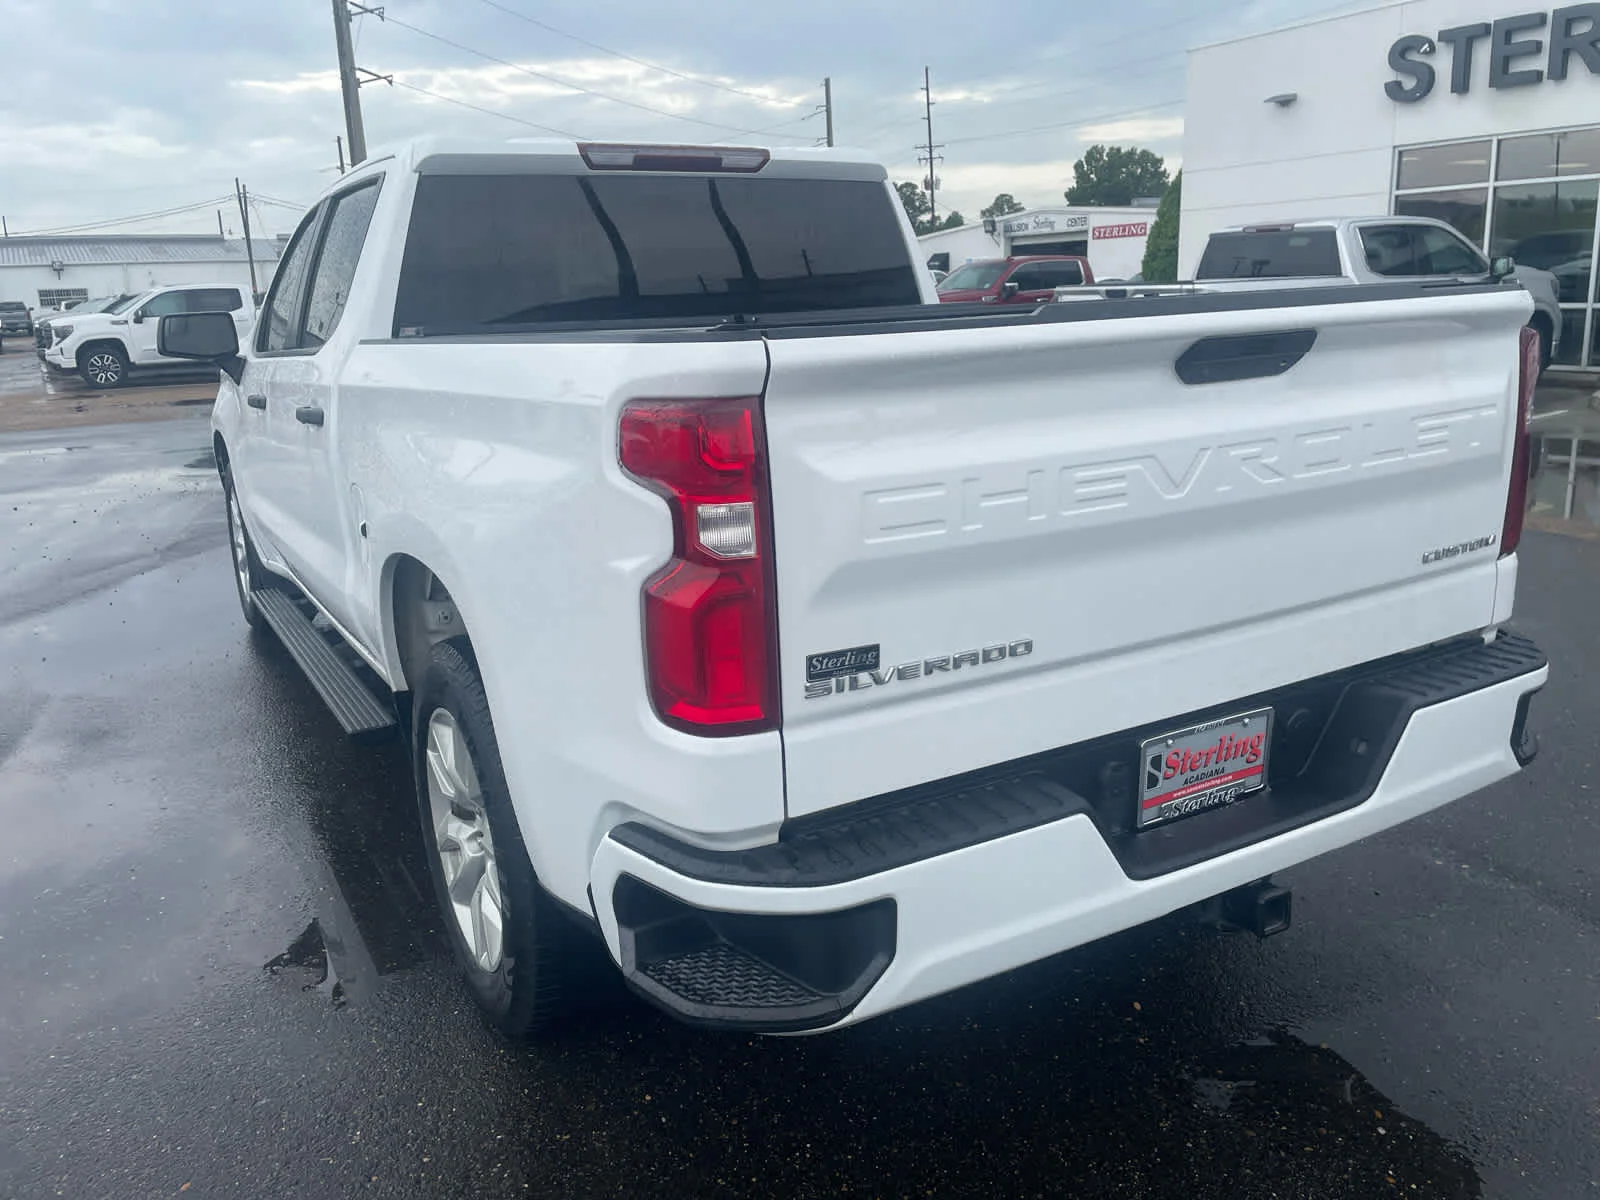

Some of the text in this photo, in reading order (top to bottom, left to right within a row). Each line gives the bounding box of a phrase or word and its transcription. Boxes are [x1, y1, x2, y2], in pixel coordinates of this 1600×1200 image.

[1384, 2, 1600, 104] STER
[1066, 216, 1087, 228] CENTER
[1093, 223, 1146, 239] STERLING
[864, 403, 1498, 545] CHEVROLET
[1422, 534, 1496, 565] CUSTOM
[804, 638, 1033, 699] SILVERADO
[810, 650, 878, 672] Sterling
[1163, 732, 1266, 780] Sterling
[1183, 766, 1225, 786] ACADIANA
